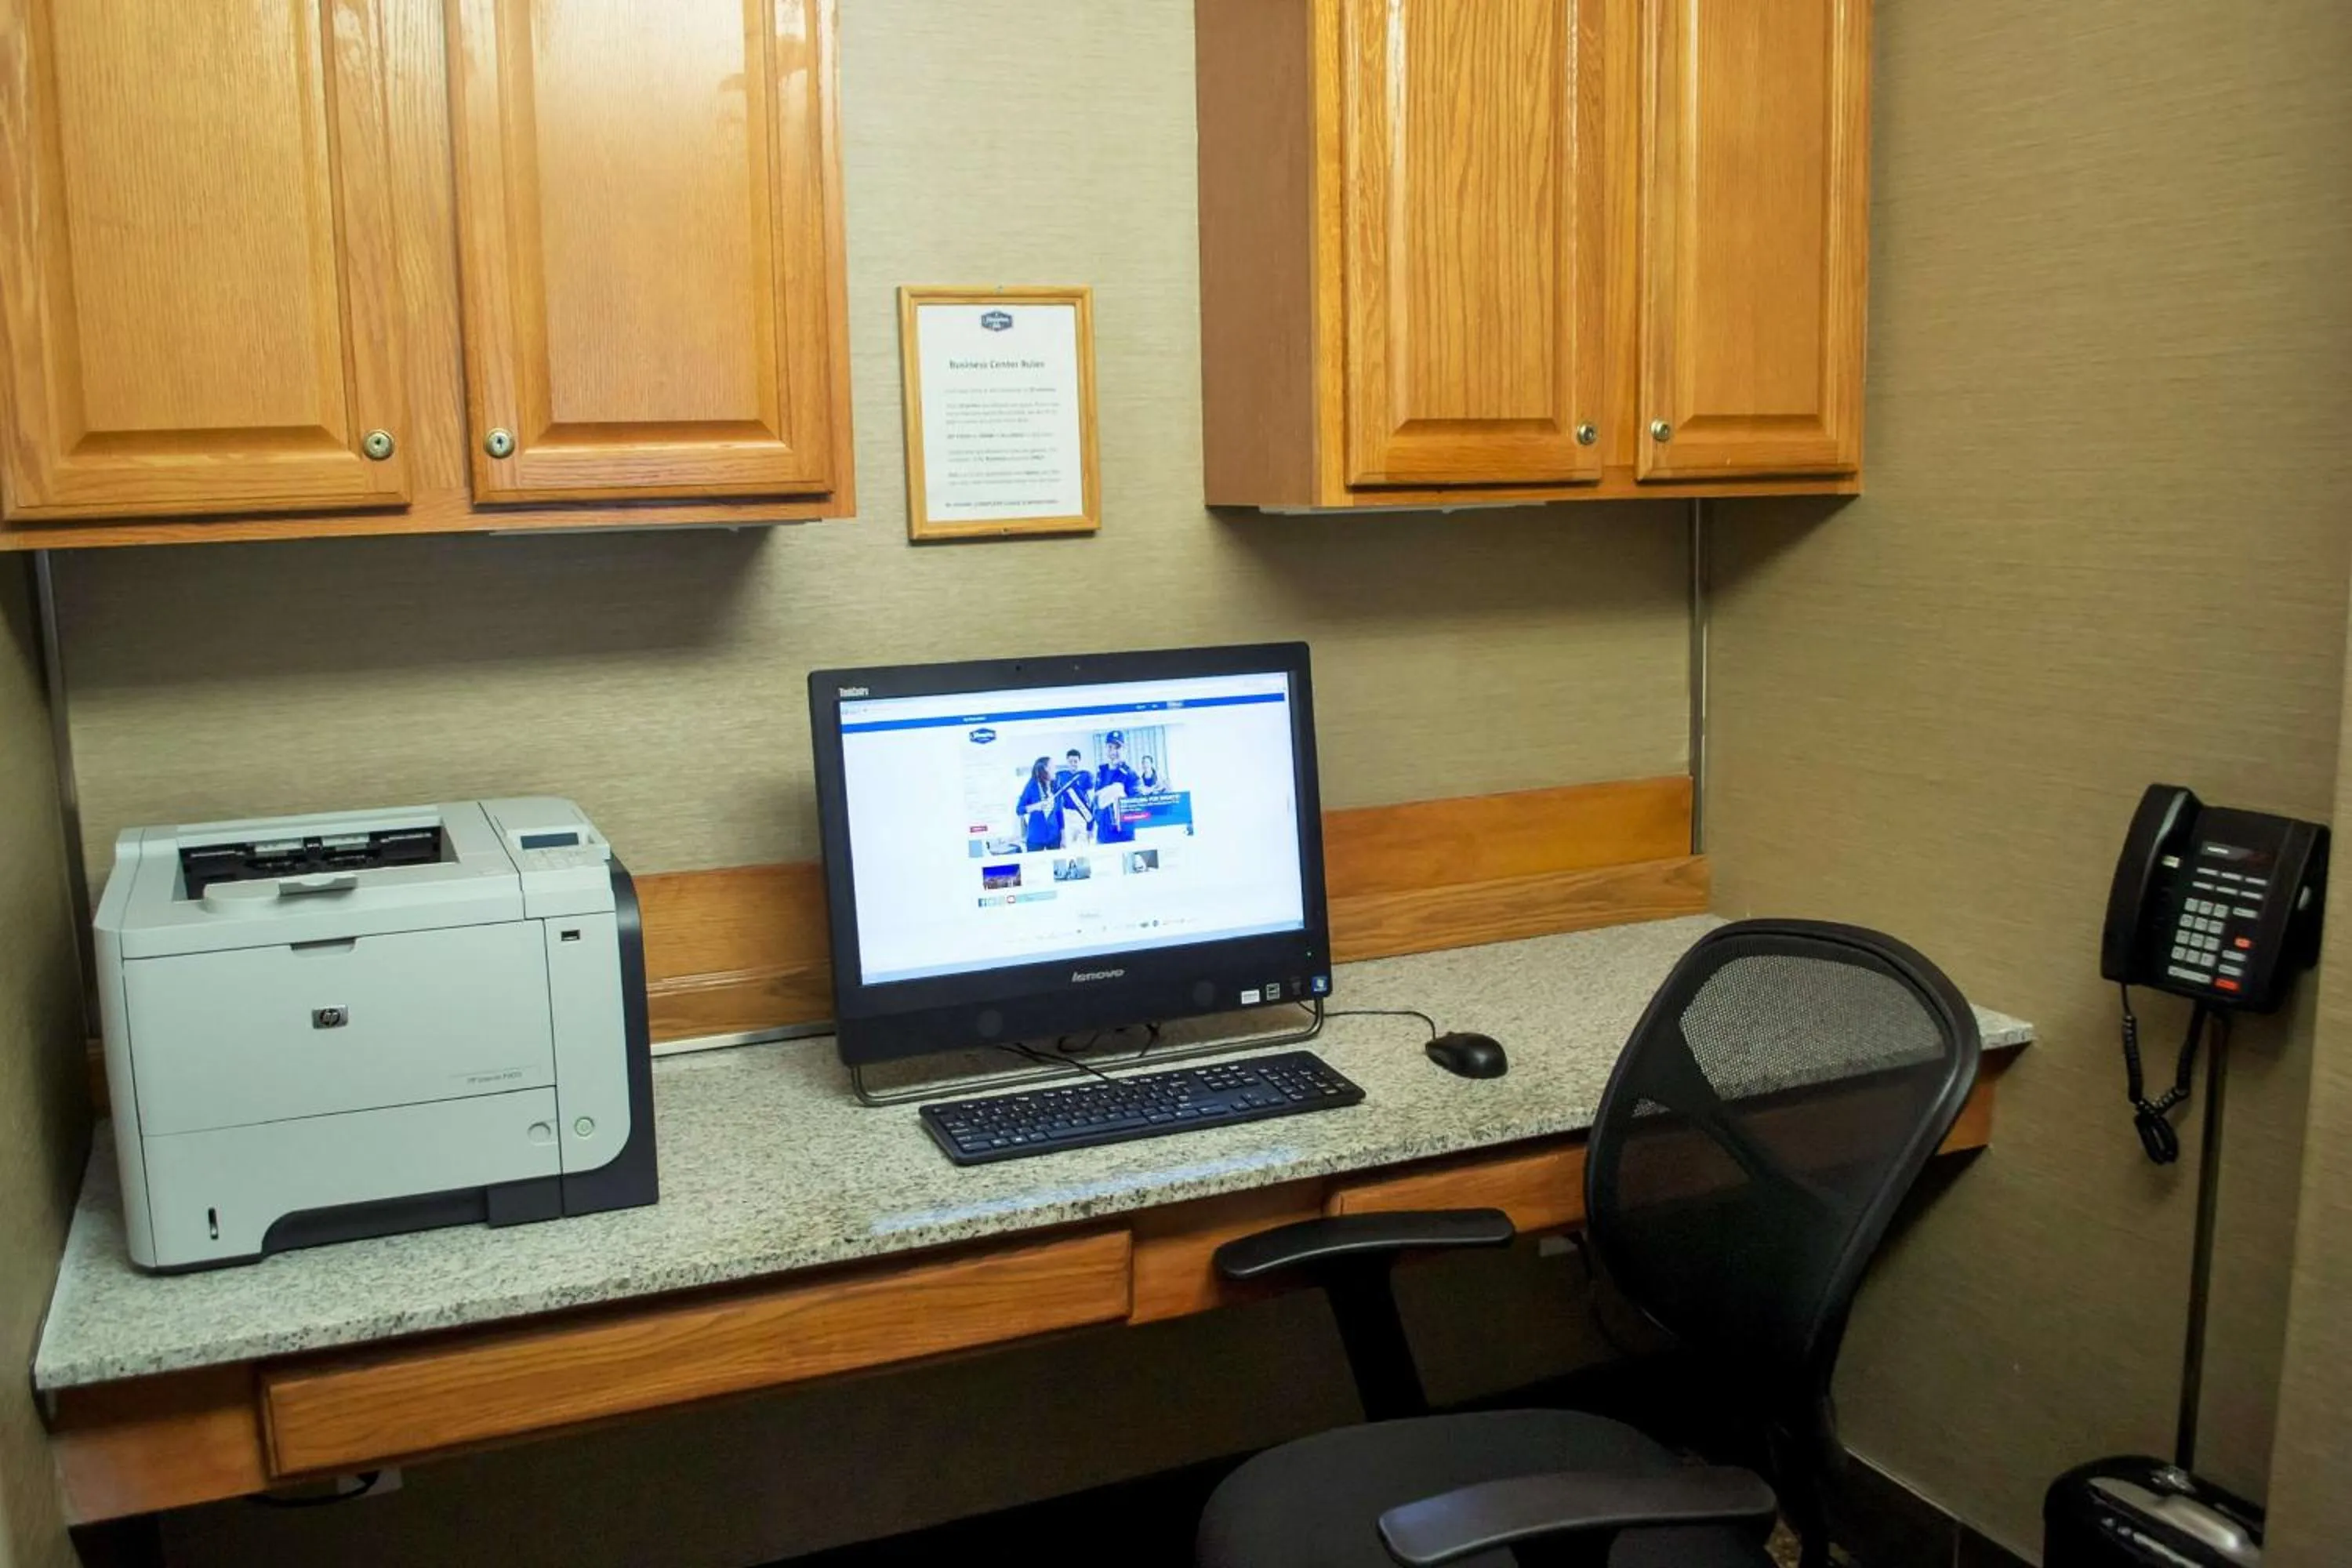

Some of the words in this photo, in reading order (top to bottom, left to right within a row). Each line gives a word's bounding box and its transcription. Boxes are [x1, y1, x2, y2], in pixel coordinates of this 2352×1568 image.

[949, 359, 988, 368] Business
[989, 359, 1018, 368] Center
[1020, 359, 1044, 368] Rules
[1072, 969, 1124, 982] lenovo
